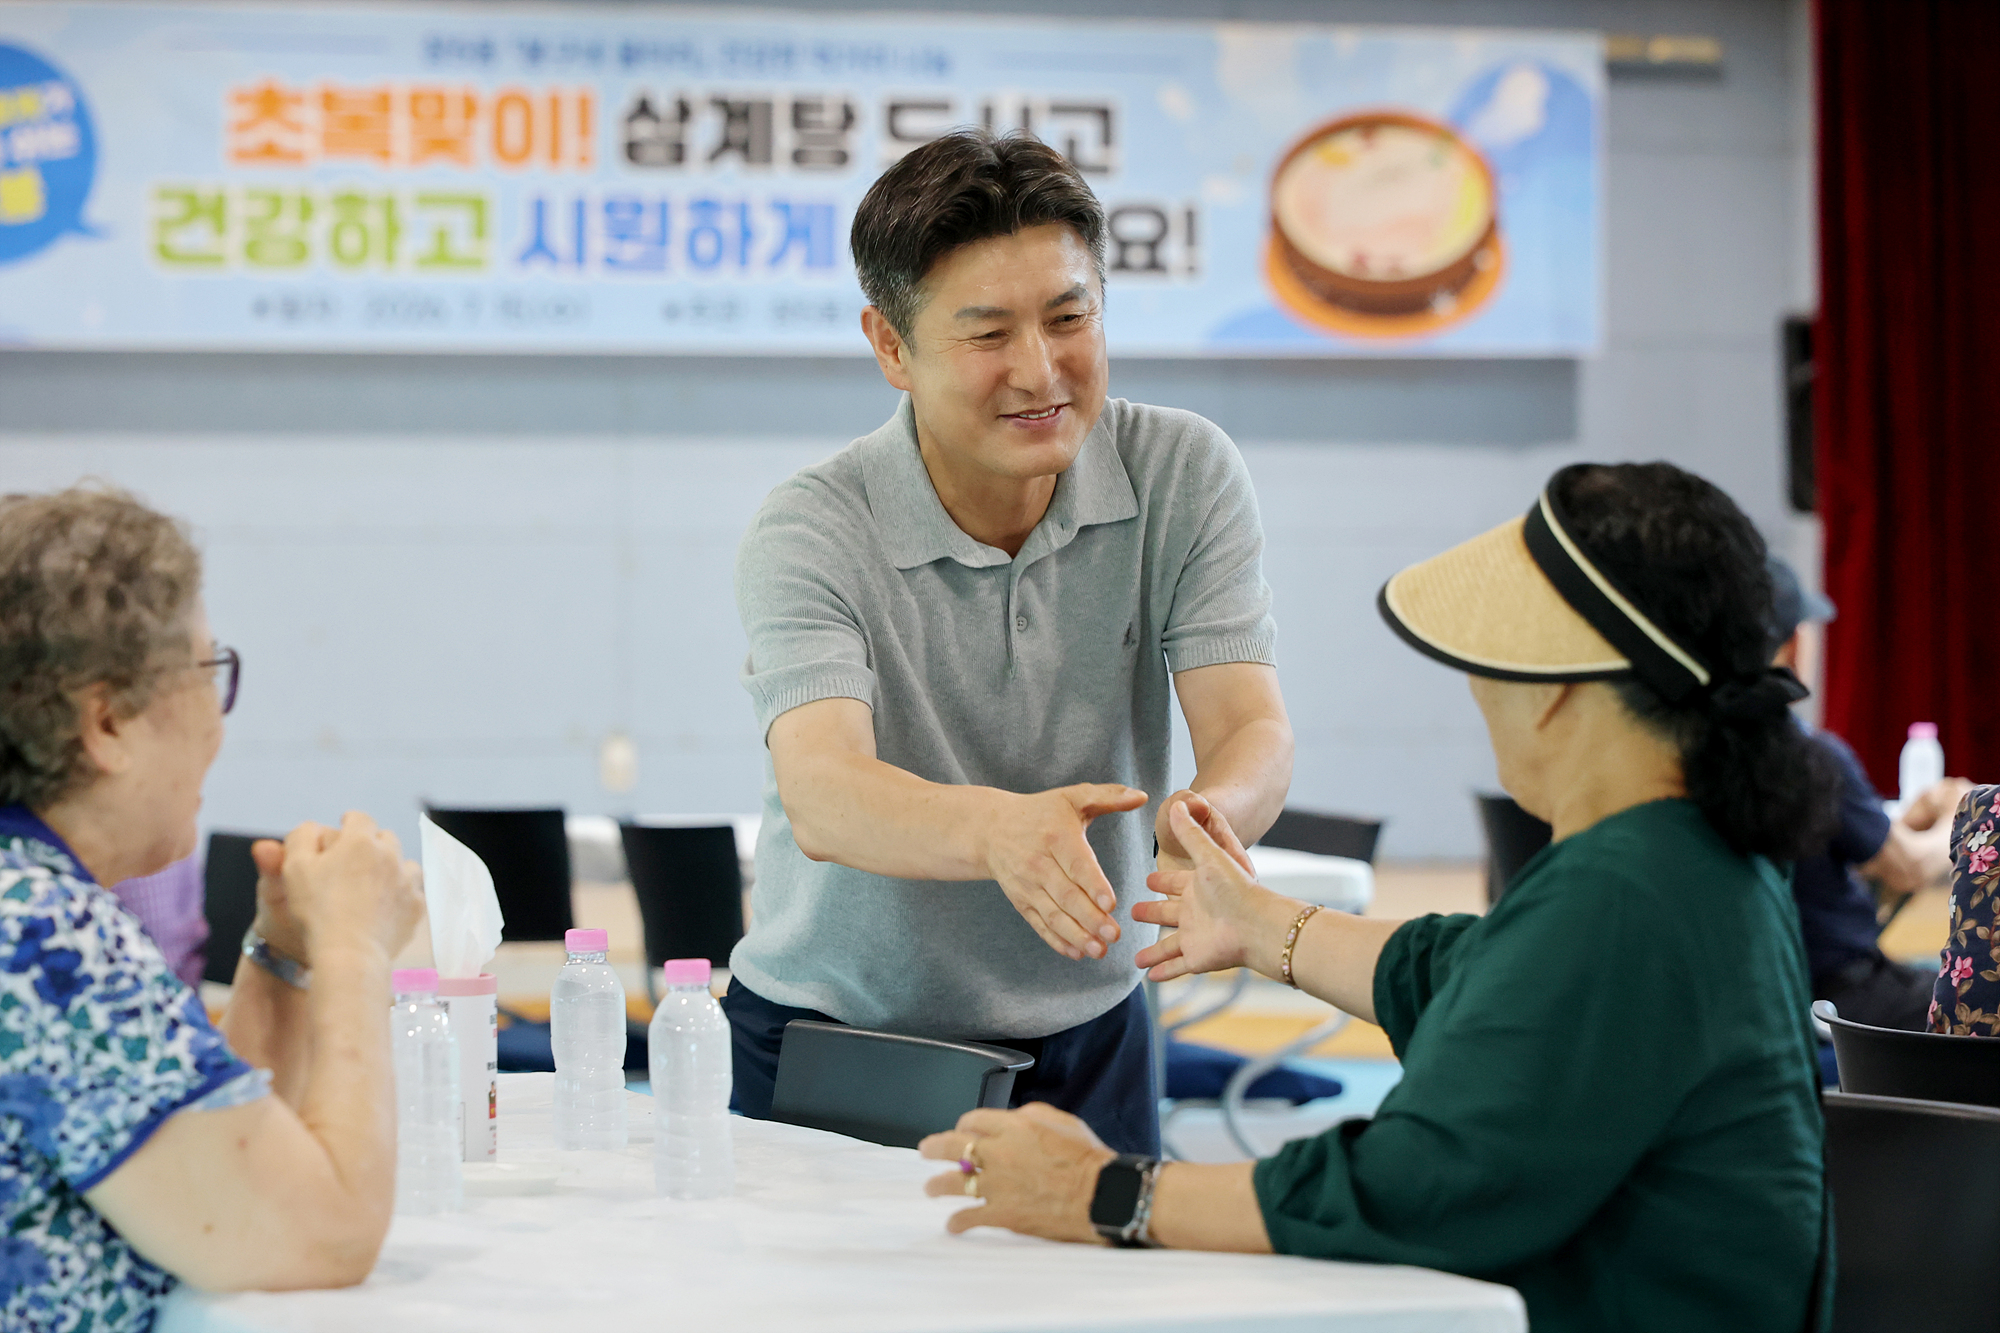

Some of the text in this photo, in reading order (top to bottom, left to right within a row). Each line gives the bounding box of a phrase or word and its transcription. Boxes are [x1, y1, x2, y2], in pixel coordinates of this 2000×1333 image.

[227, 80, 593, 167] 초복맞이!
[623, 95, 857, 170] 삼계탕
[152, 187, 1200, 276] 건강하고 시원하게 요!
